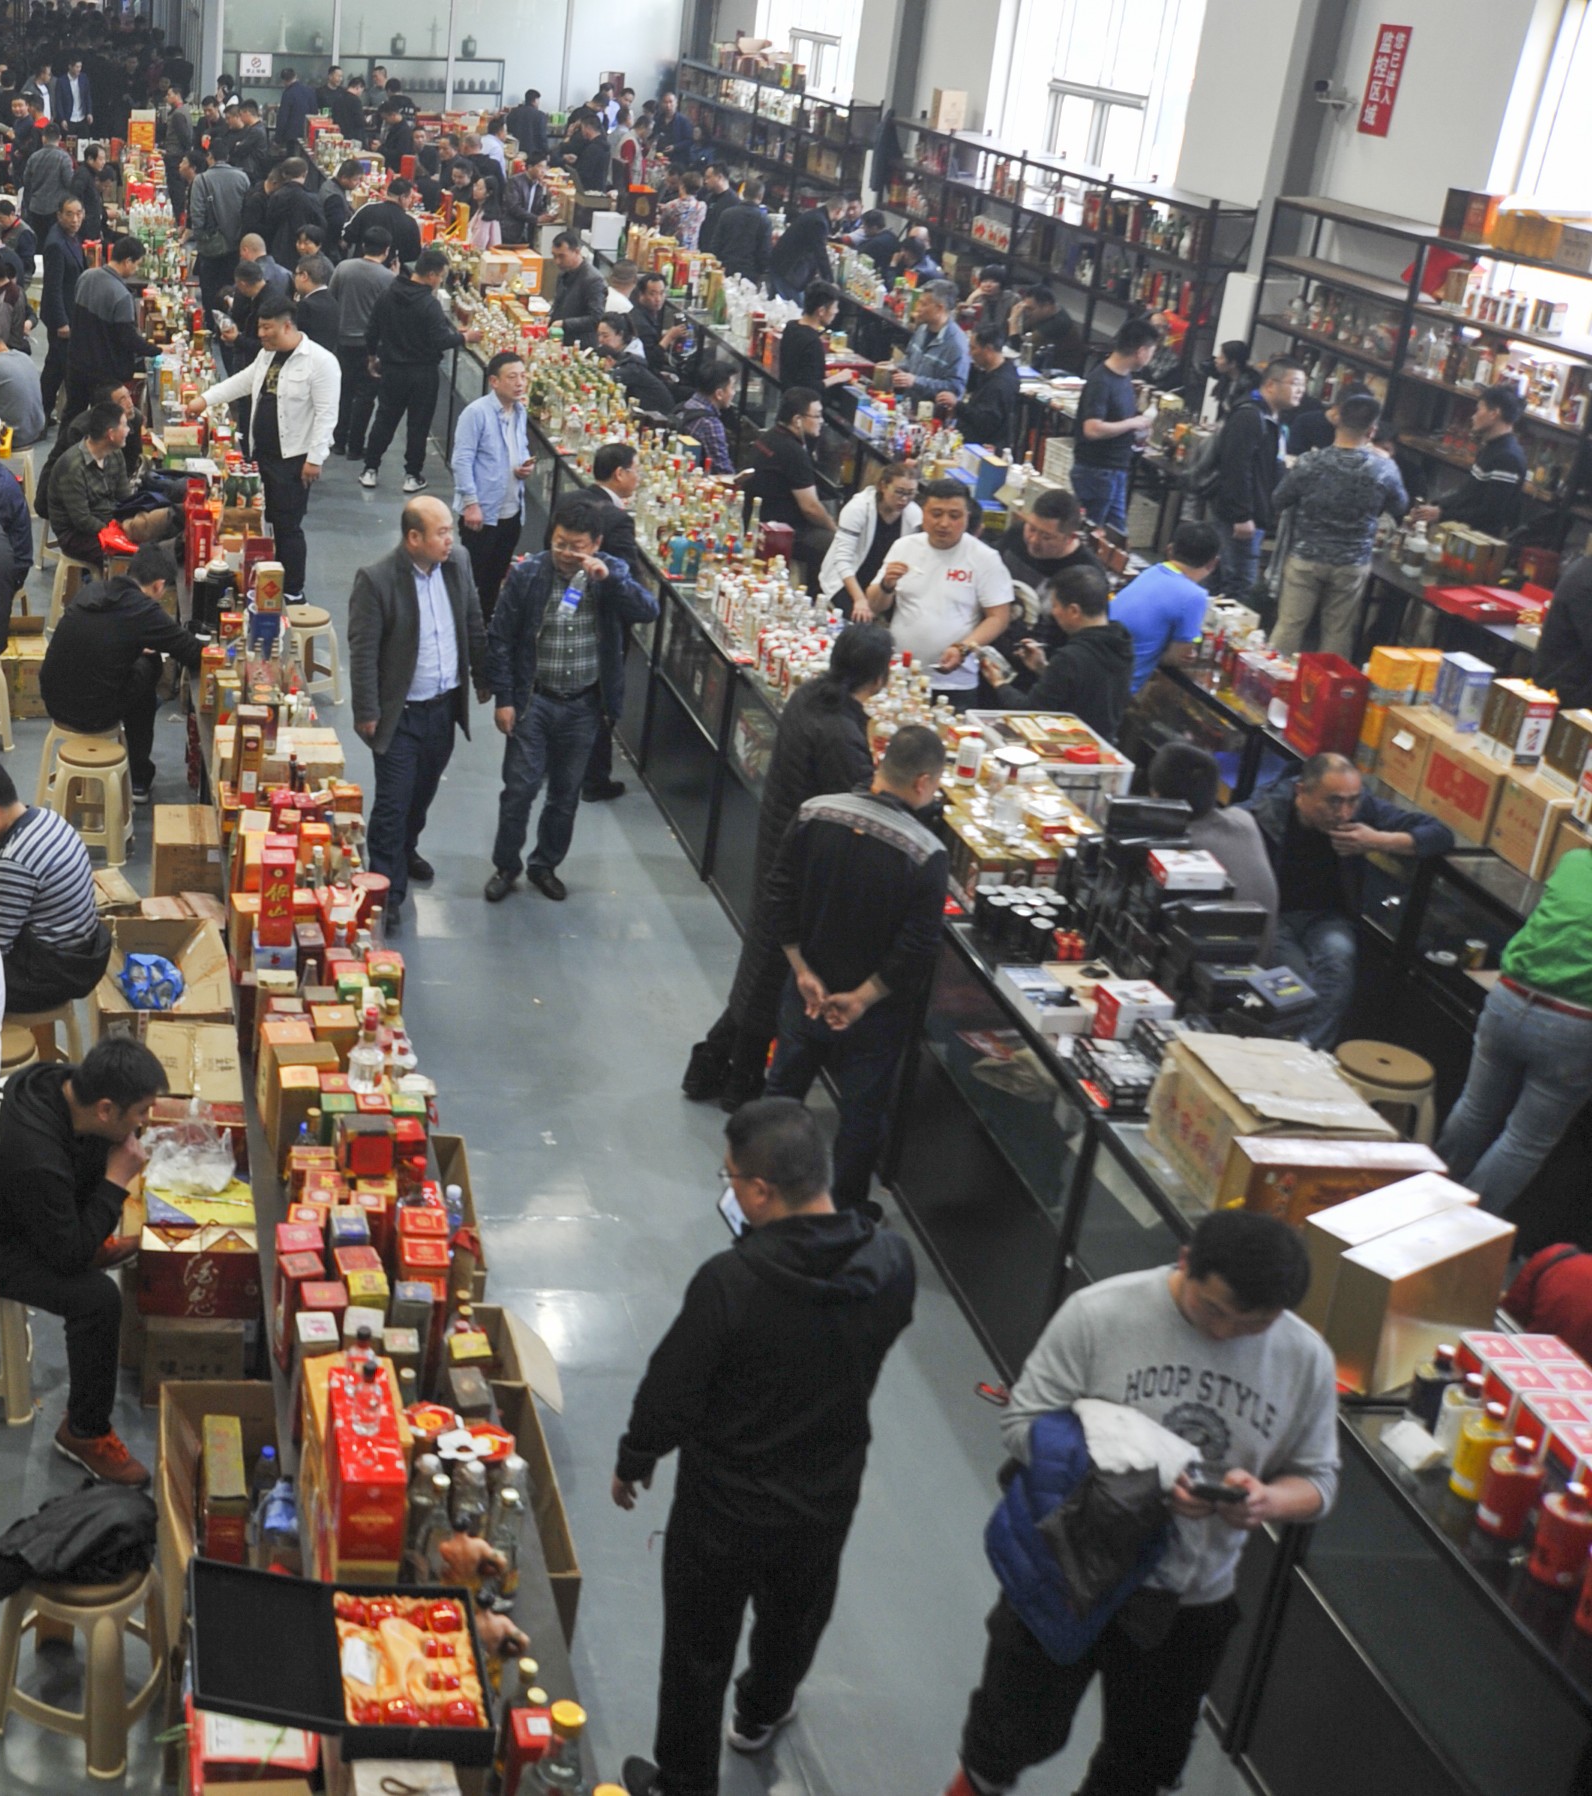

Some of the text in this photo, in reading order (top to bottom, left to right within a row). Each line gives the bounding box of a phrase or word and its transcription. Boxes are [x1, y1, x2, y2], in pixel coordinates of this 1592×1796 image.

[1363, 31, 1394, 126] 监控区域
[1380, 32, 1407, 105] 您已进入
[1123, 1364, 1277, 1439] HOOP STYLE
